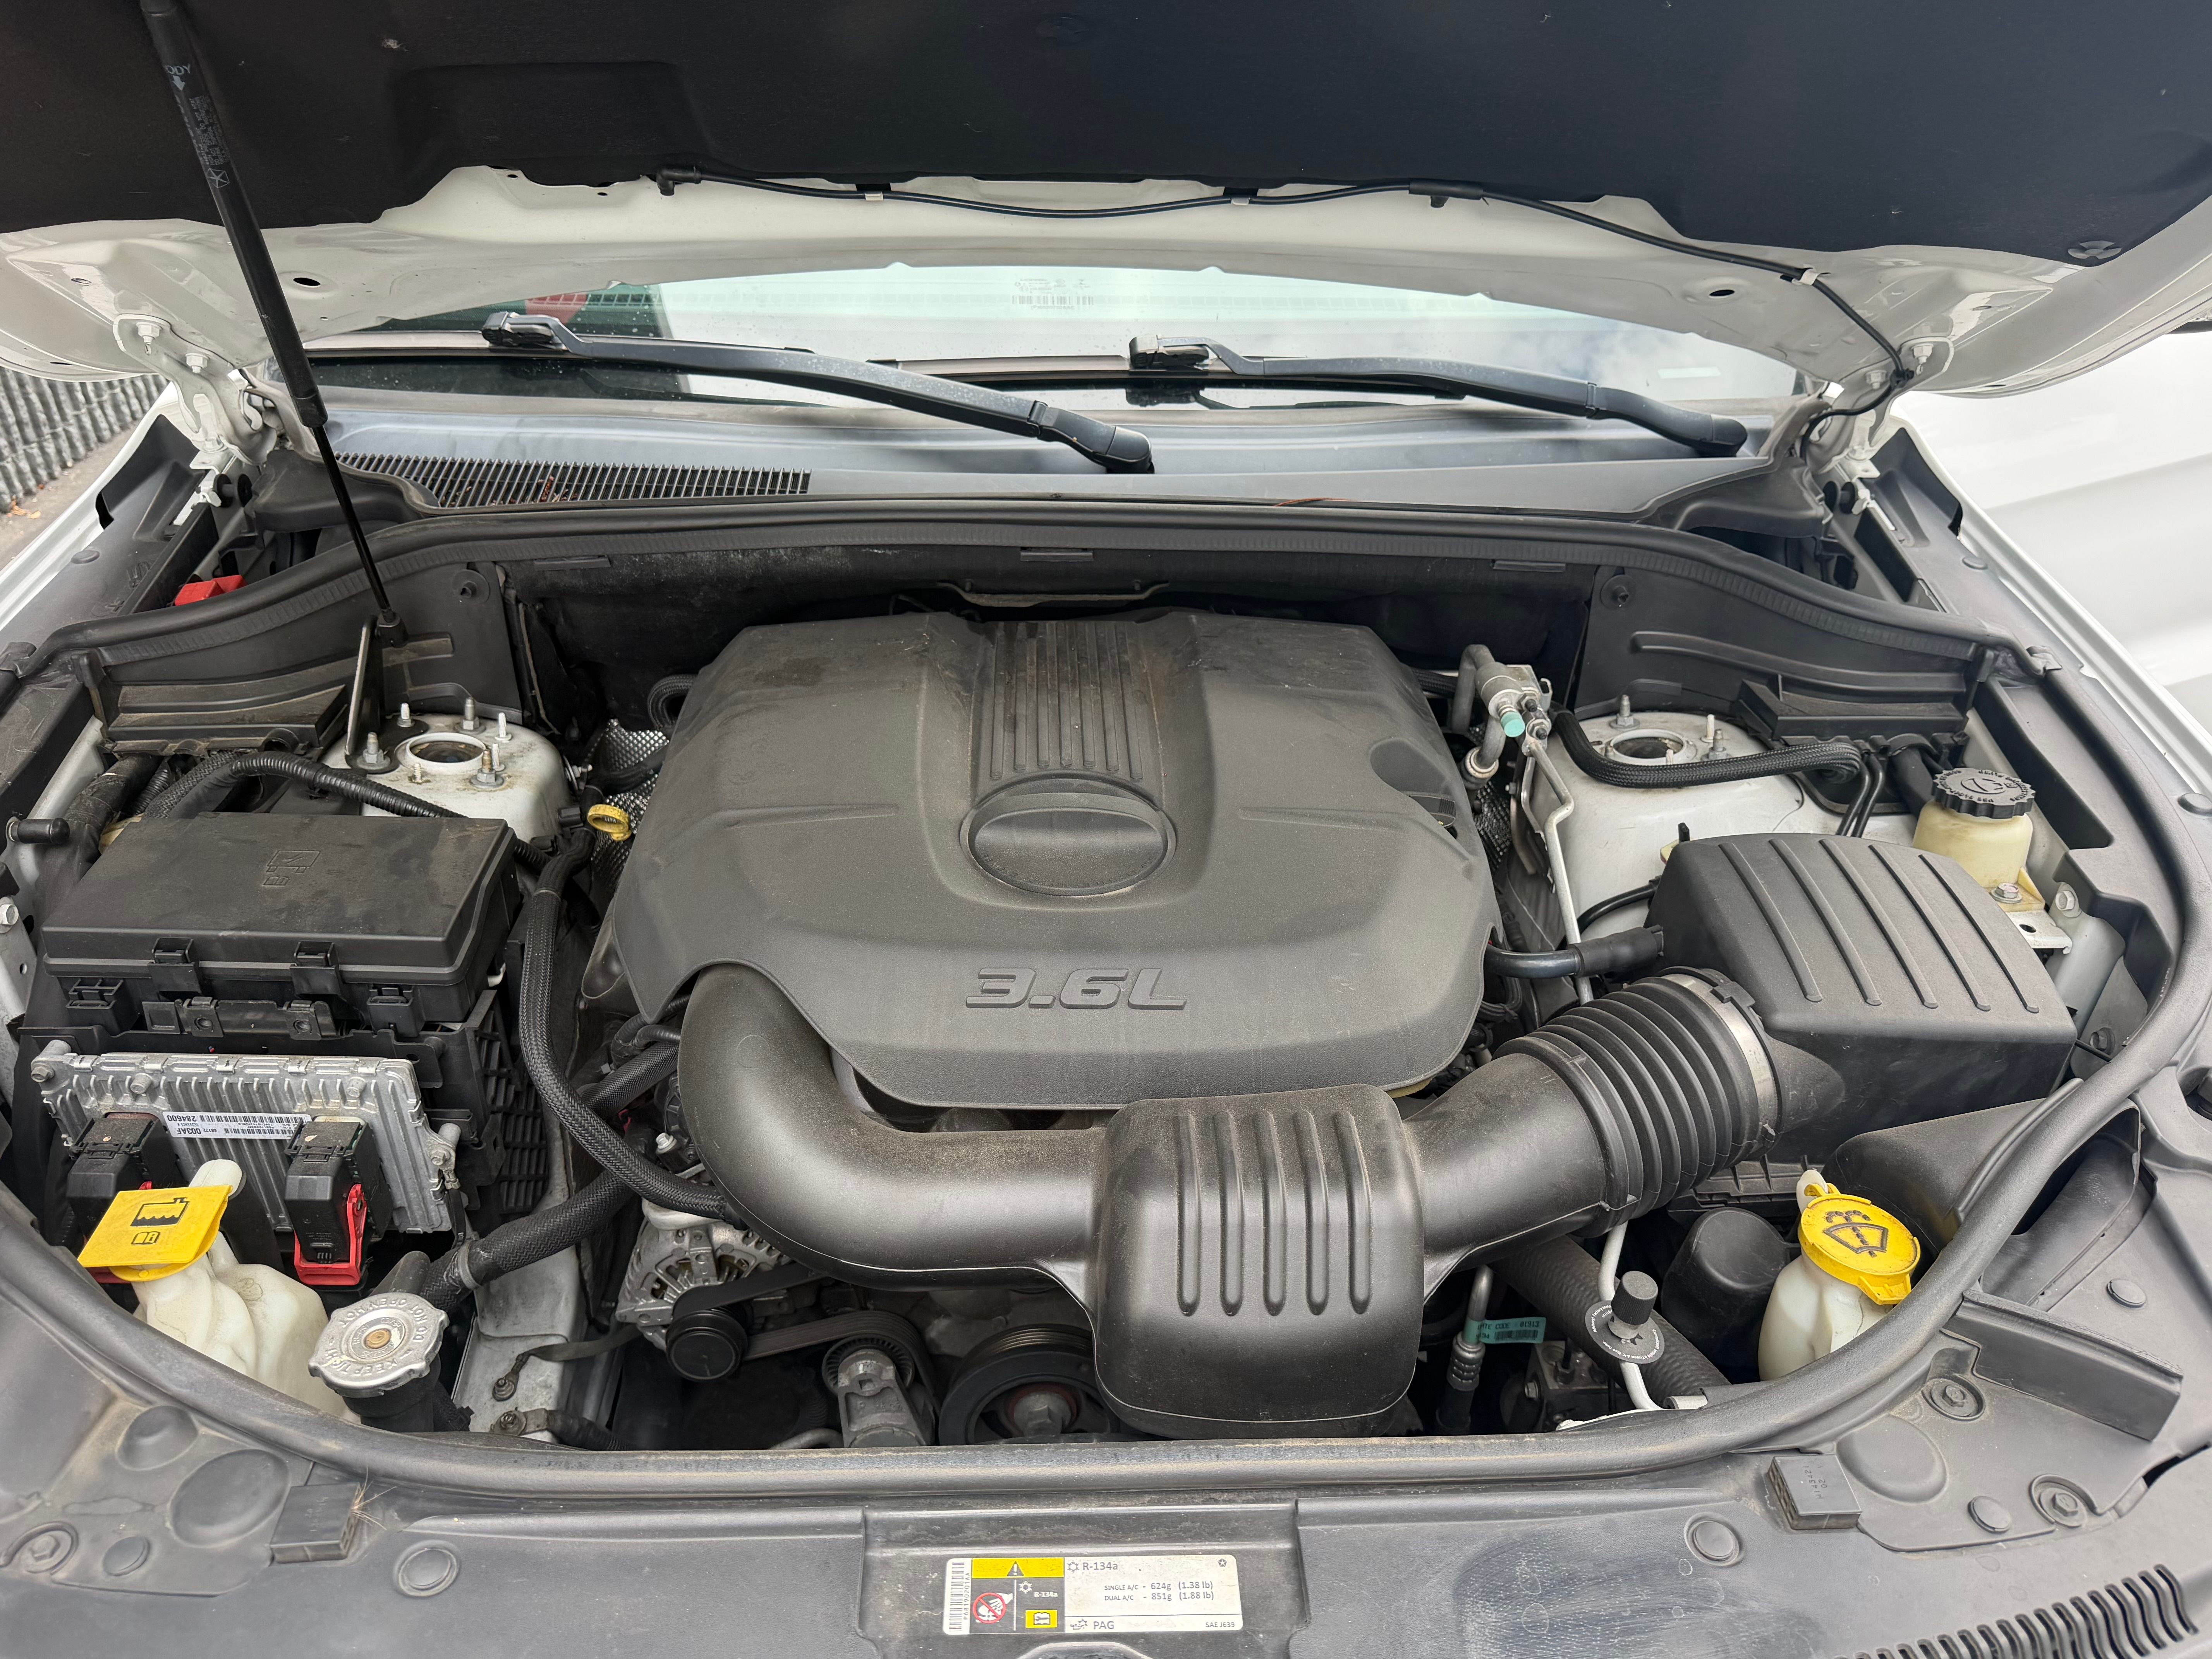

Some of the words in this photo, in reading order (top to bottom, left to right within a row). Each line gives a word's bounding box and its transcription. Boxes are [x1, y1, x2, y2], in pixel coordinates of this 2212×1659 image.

[165, 64, 191, 75] ODY
[966, 968, 1187, 1010] 3.6L
[369, 1298, 408, 1310] OPEN
[340, 1308, 366, 1328] HOT
[409, 1305, 428, 1324] NOT
[357, 1359, 397, 1376] KEEP
[1082, 1562, 1118, 1570] R-134a
[1151, 1583, 1171, 1591] 624g
[1178, 1581, 1200, 1590] (1.38
[1202, 1581, 1213, 1590] lb)
[1151, 1593, 1172, 1601] 851g
[1179, 1592, 1201, 1601] (1.88
[1203, 1591, 1214, 1601] lb)
[1093, 1621, 1115, 1630] PAG
